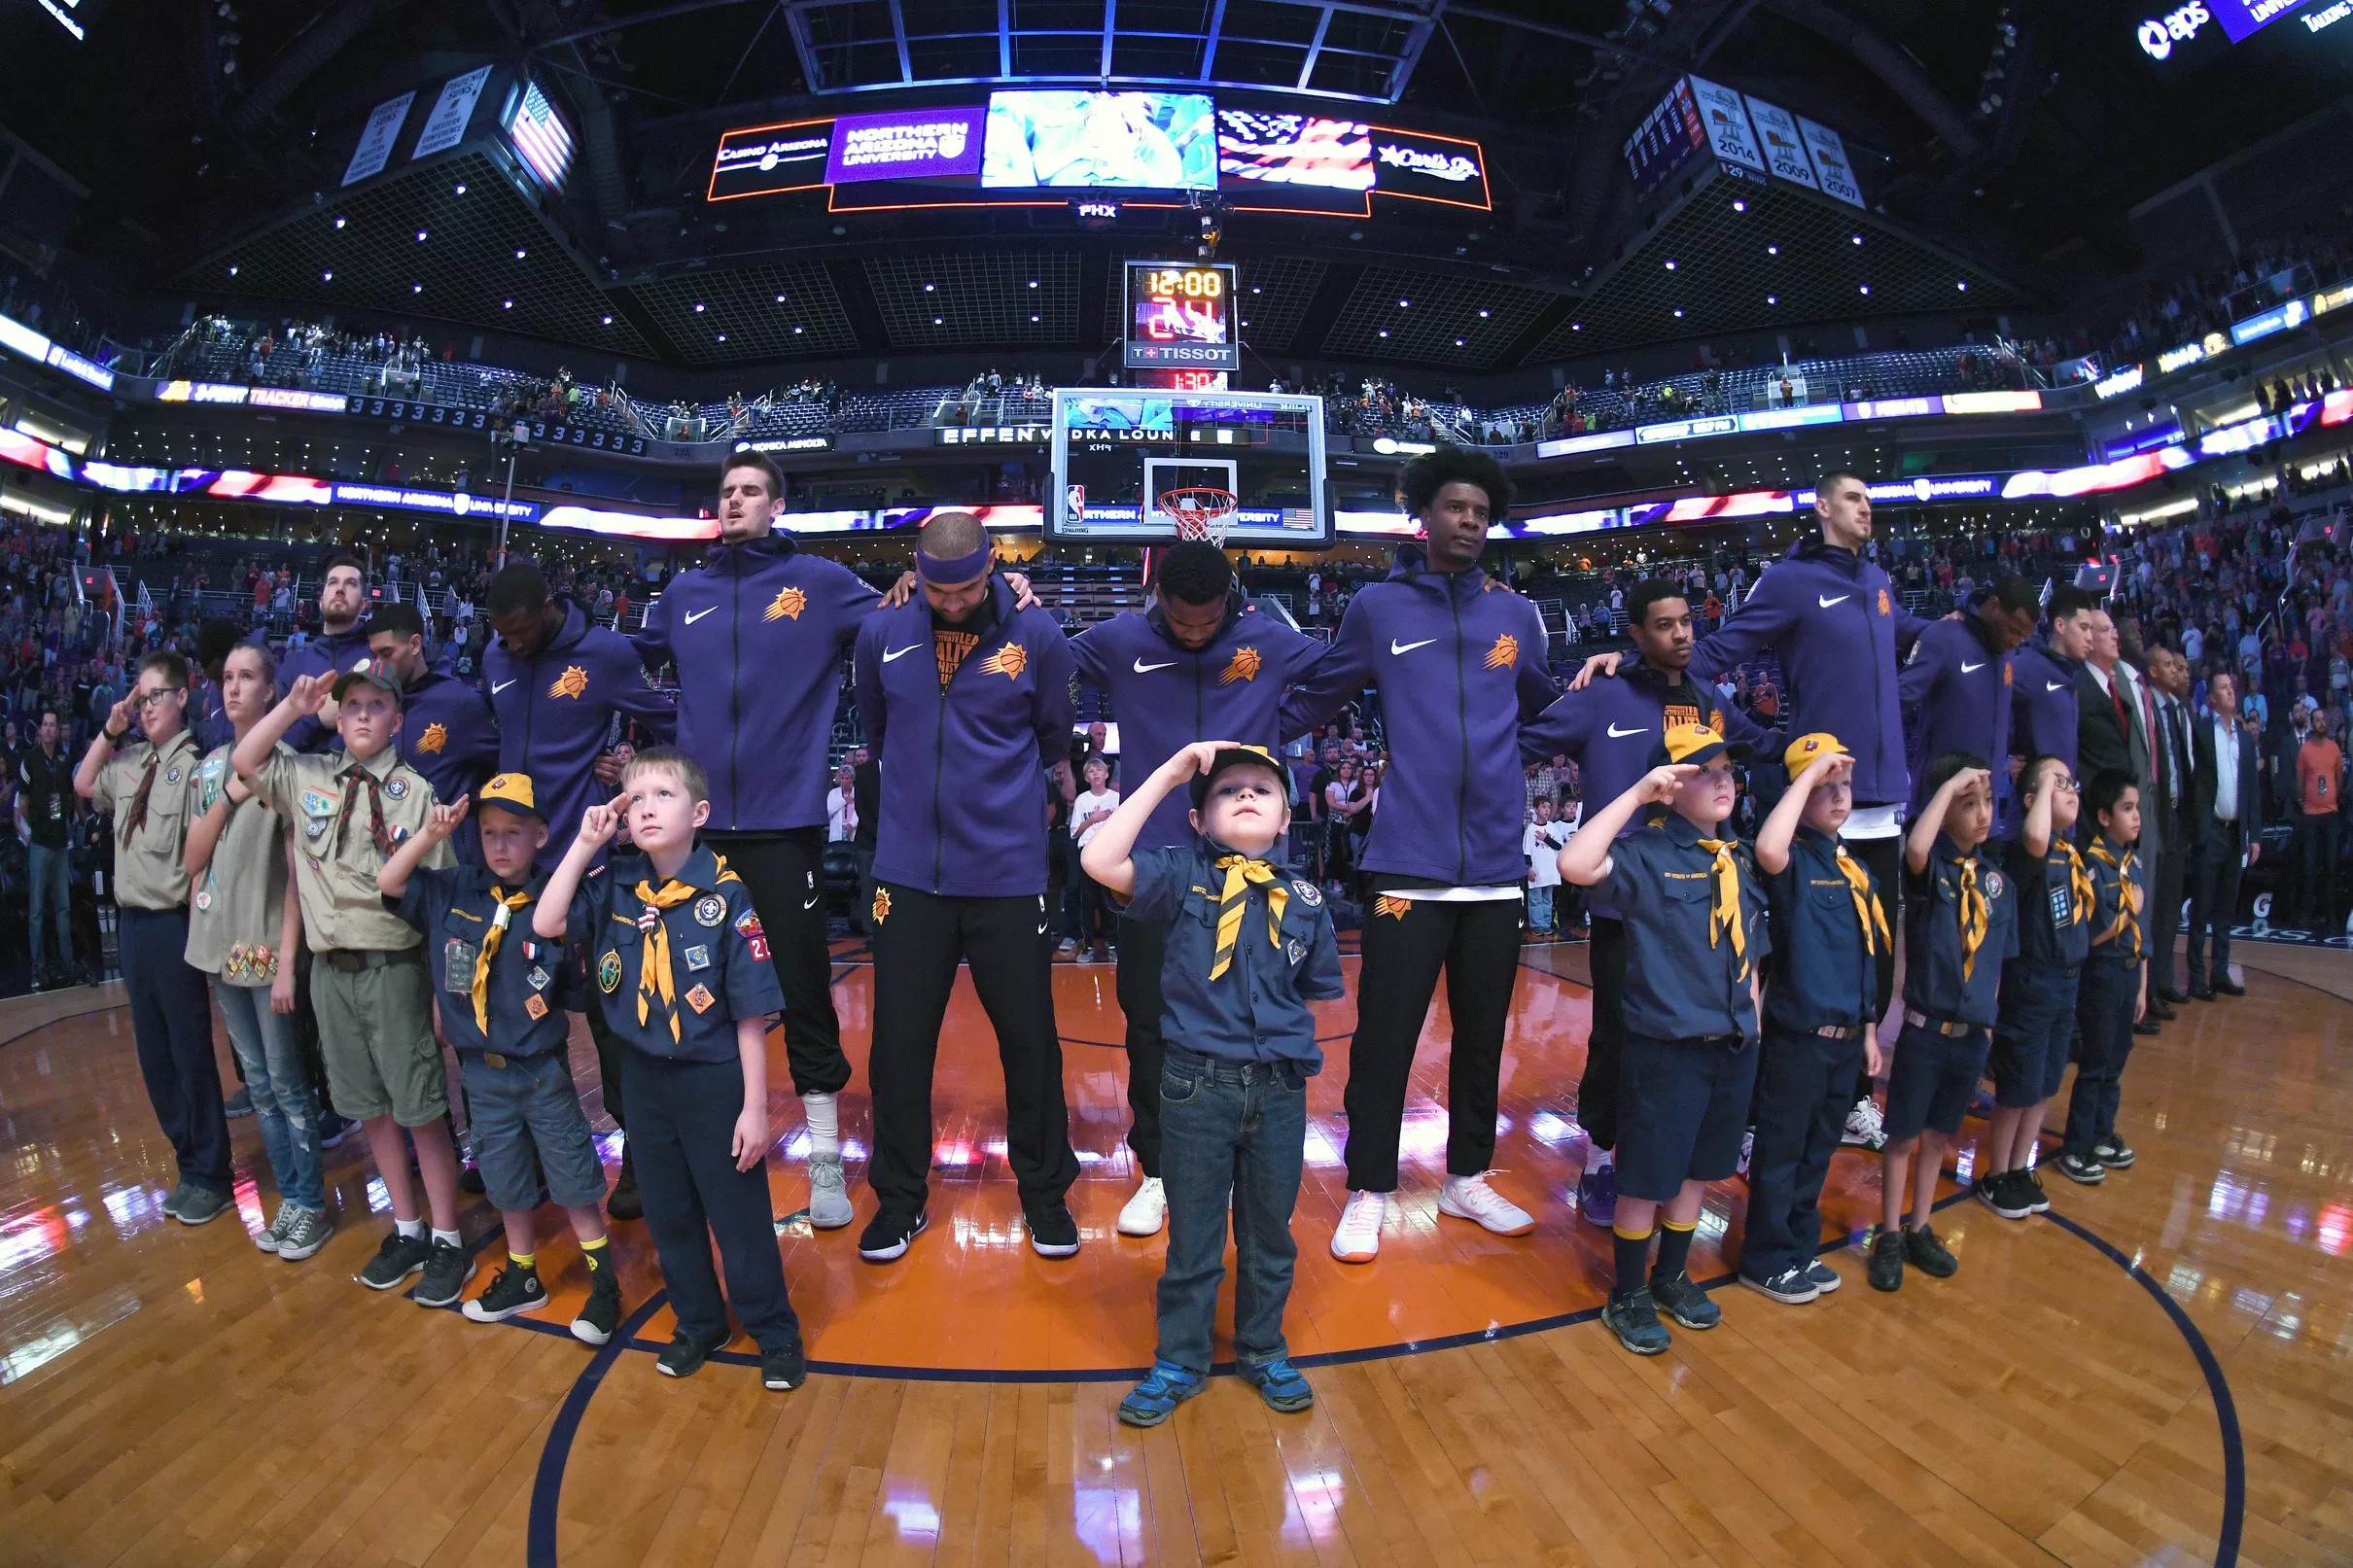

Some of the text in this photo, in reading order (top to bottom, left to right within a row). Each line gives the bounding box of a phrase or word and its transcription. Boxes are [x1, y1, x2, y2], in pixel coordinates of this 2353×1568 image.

[2163, 0, 2210, 40] aps
[447, 84, 473, 100] SUNS
[847, 122, 968, 143] NORTHERN
[719, 138, 828, 161] CASINO ARIZONA
[843, 137, 938, 156] ARIZONA
[1718, 139, 1755, 161] 2014
[842, 149, 937, 166] UNIVERSITY
[1728, 164, 1743, 179] 29
[1774, 158, 1809, 181] 2009
[1824, 178, 1856, 200] 2007
[1079, 204, 1116, 218] PHX
[1150, 270, 1221, 296] 12:00
[1159, 348, 1231, 361] TISSOT
[250, 389, 310, 407] TRACKER
[351, 399, 364, 413] 3
[371, 401, 384, 415] 3
[392, 402, 404, 418] 3
[412, 405, 425, 420] 3
[433, 408, 444, 423] 3
[452, 411, 466, 426] 3
[473, 414, 486, 429] 3
[533, 423, 545, 436] 3
[553, 427, 566, 440] 3
[574, 430, 585, 443] 3
[593, 433, 605, 447] 3
[613, 436, 624, 450] 3
[632, 439, 643, 453] 3
[943, 428, 1201, 443] EFFEN VDKA LOUNE
[336, 486, 402, 504] NORTHERN
[402, 493, 454, 509] ARIZONA
[1930, 480, 1992, 495] UNIVERSITY
[1083, 508, 1136, 521] RTHERN
[2254, 892, 2273, 918] G
